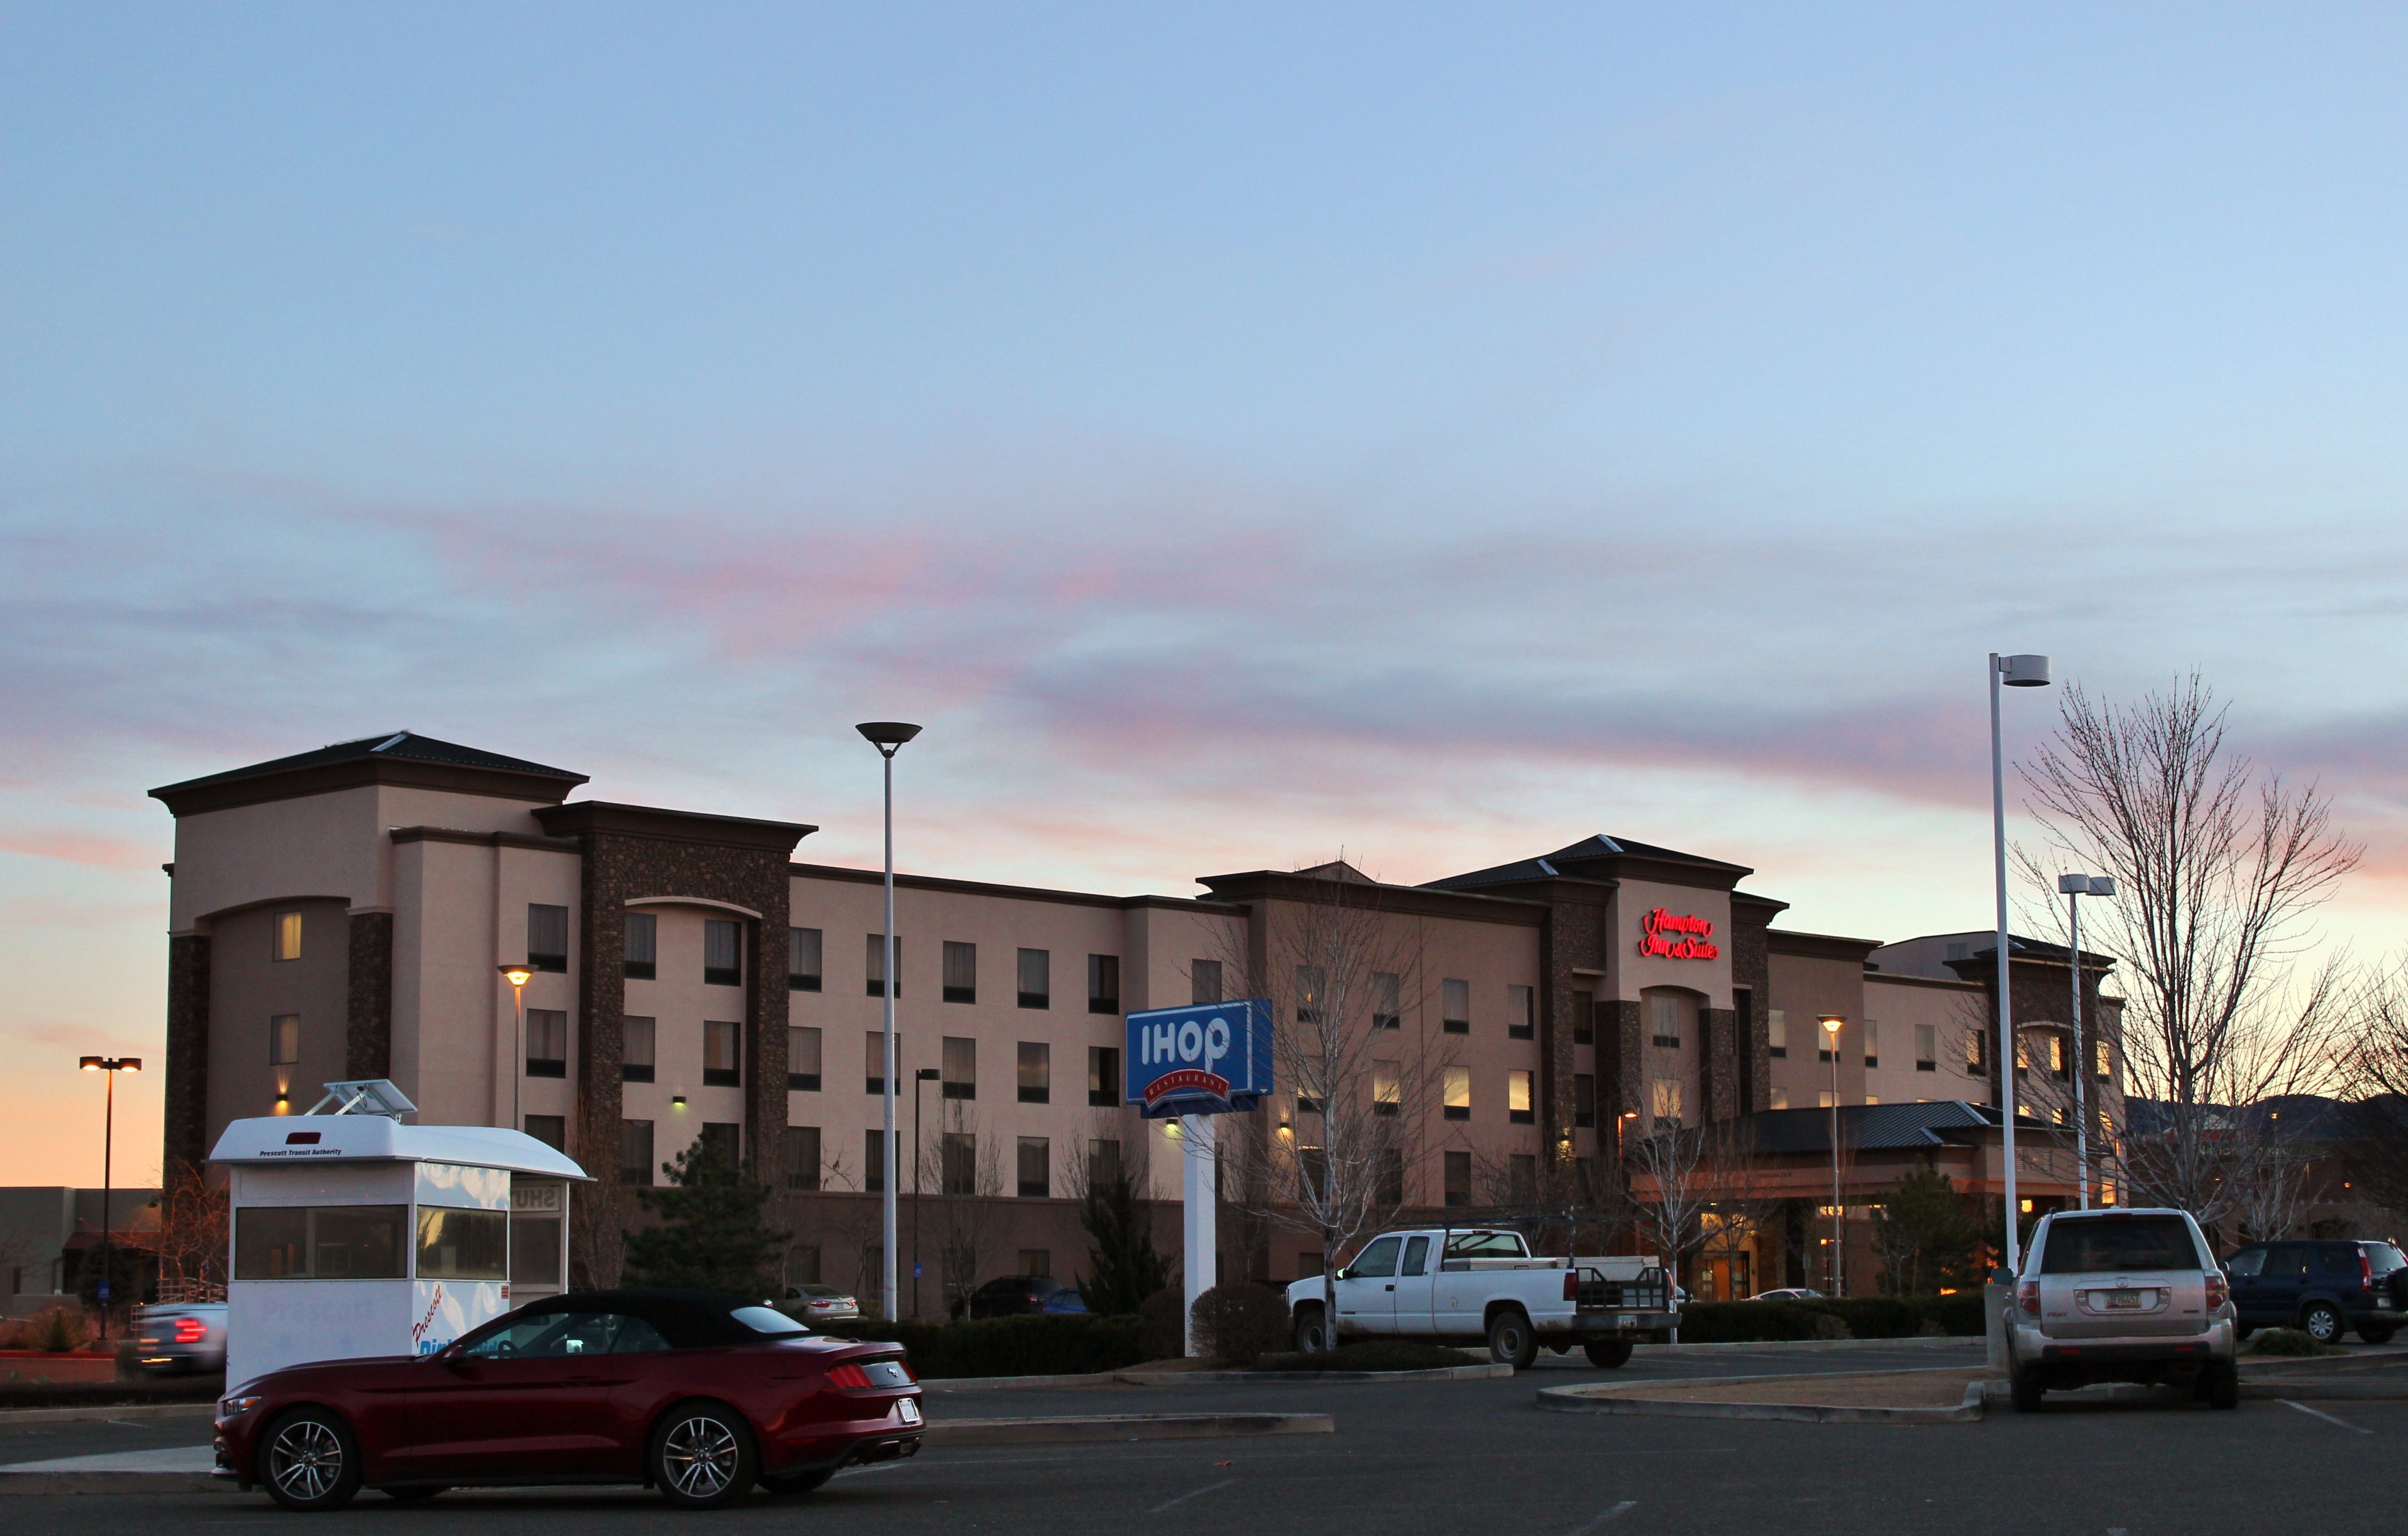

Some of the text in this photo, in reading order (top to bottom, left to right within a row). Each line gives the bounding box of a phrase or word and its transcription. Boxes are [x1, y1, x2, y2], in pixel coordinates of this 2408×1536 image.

[1642, 908, 1714, 938] Hampton
[1640, 934, 1675, 958] Inn
[1683, 936, 1720, 959] Suites
[1141, 1017, 1230, 1075] IHOP
[1149, 1075, 1222, 1096] RESTAURANT
[412, 1283, 442, 1348] Prescott
